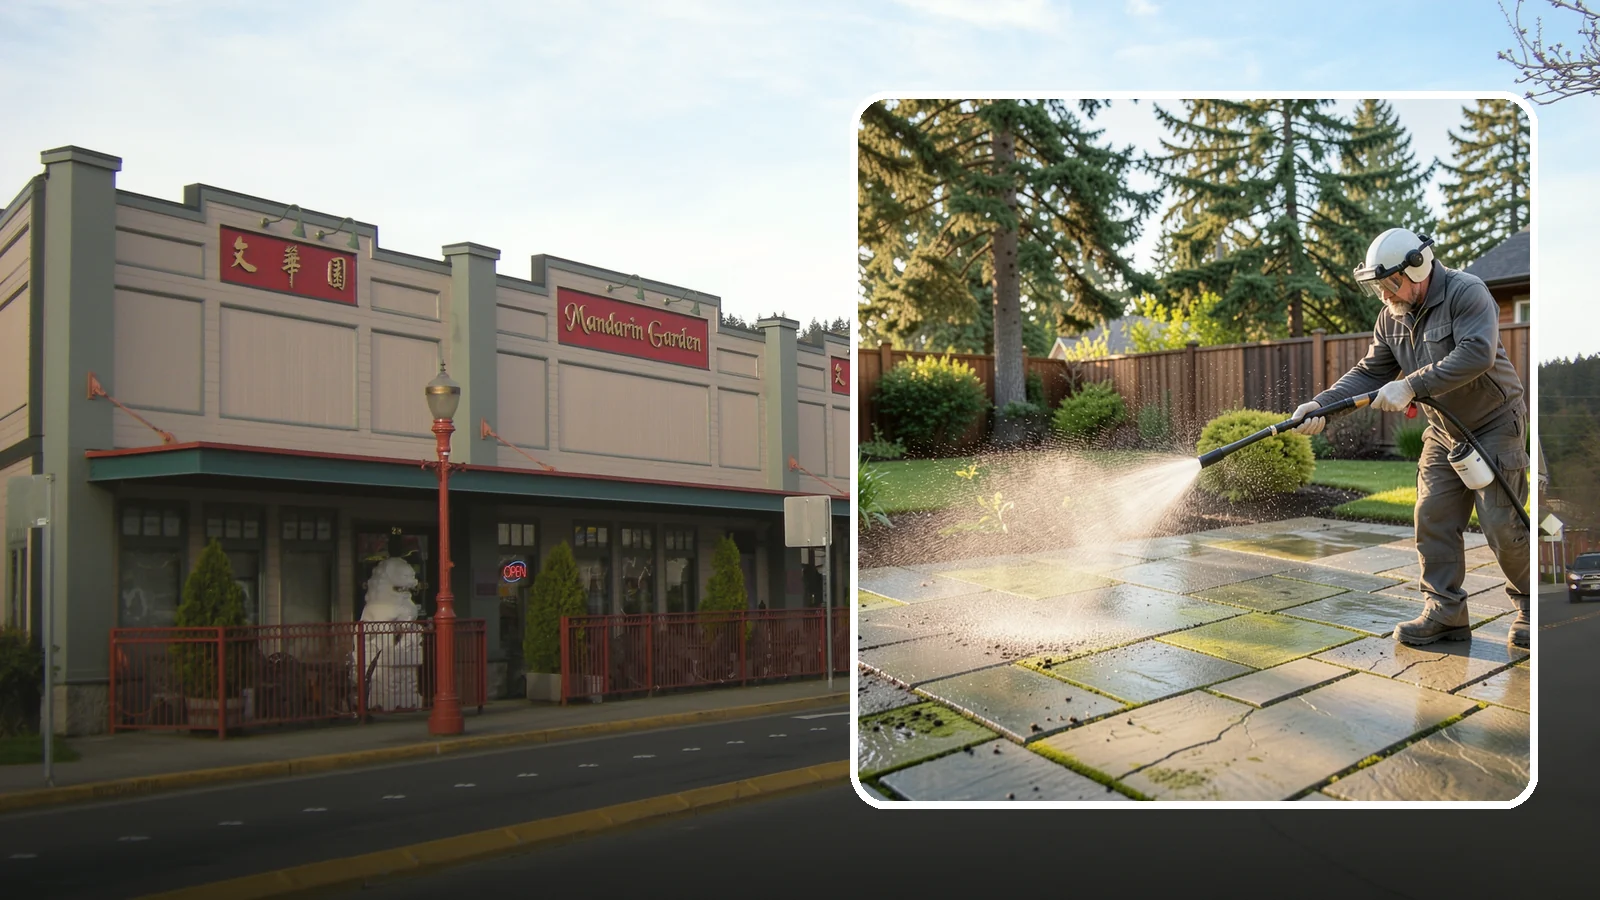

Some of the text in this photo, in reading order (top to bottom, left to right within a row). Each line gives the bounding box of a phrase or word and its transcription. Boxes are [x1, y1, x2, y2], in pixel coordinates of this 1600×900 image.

[231, 235, 346, 290] 文華園
[565, 302, 701, 352] Mandarin Garden
[503, 565, 527, 578] OPEN
